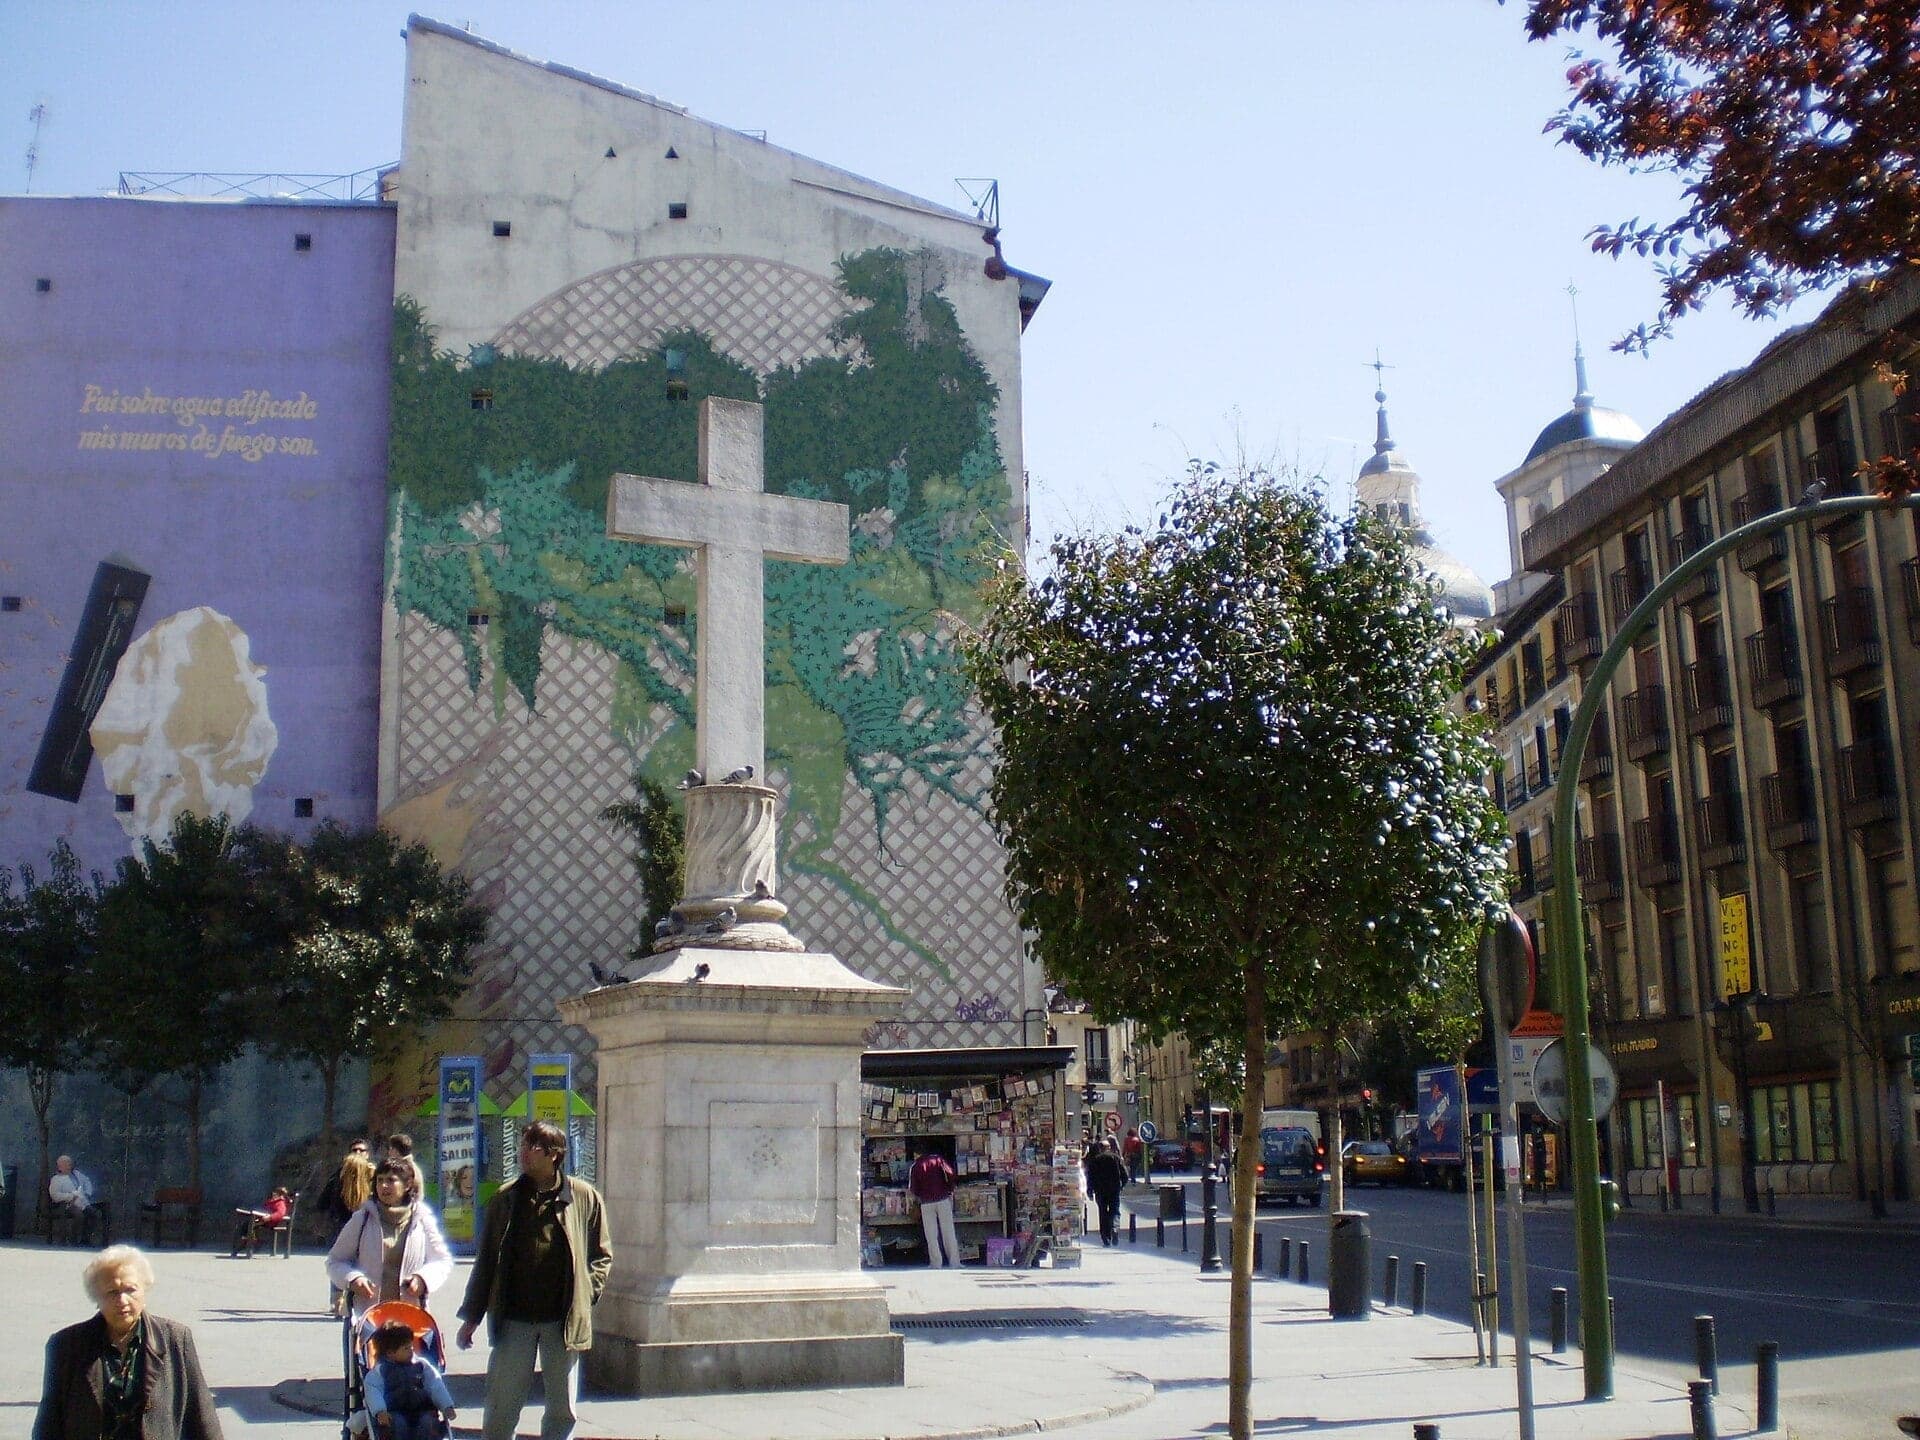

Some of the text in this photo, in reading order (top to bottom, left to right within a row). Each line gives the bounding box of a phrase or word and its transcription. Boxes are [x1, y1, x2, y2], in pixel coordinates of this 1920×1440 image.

[80, 383, 318, 427] Fui sobre agua edificada
[78, 424, 119, 450] mis
[119, 431, 188, 450] muros
[191, 423, 217, 451] de
[204, 424, 277, 462] fuego
[1721, 903, 1734, 993] VENTA
